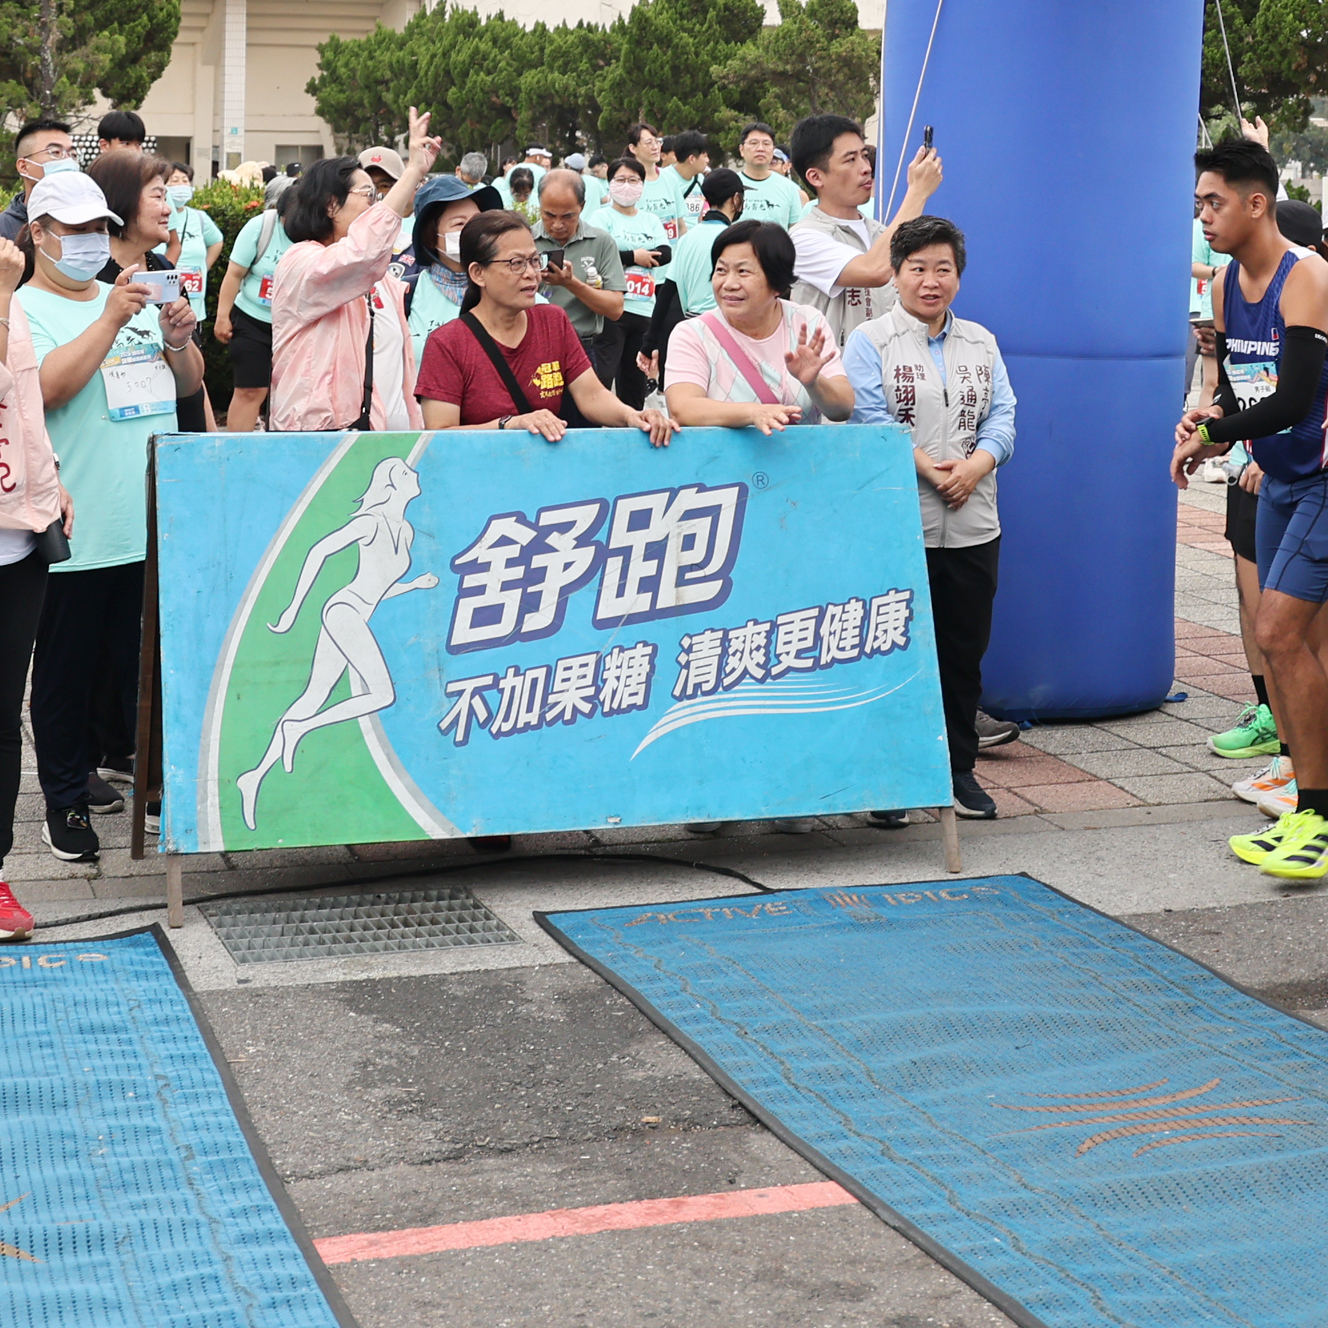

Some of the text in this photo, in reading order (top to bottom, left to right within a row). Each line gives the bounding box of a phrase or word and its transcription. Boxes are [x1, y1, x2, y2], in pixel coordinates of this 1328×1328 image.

[956, 365, 977, 432] 吳通龍
[448, 484, 745, 651] 舒跑
[439, 589, 914, 744] 不加果糖 清爽更健康
